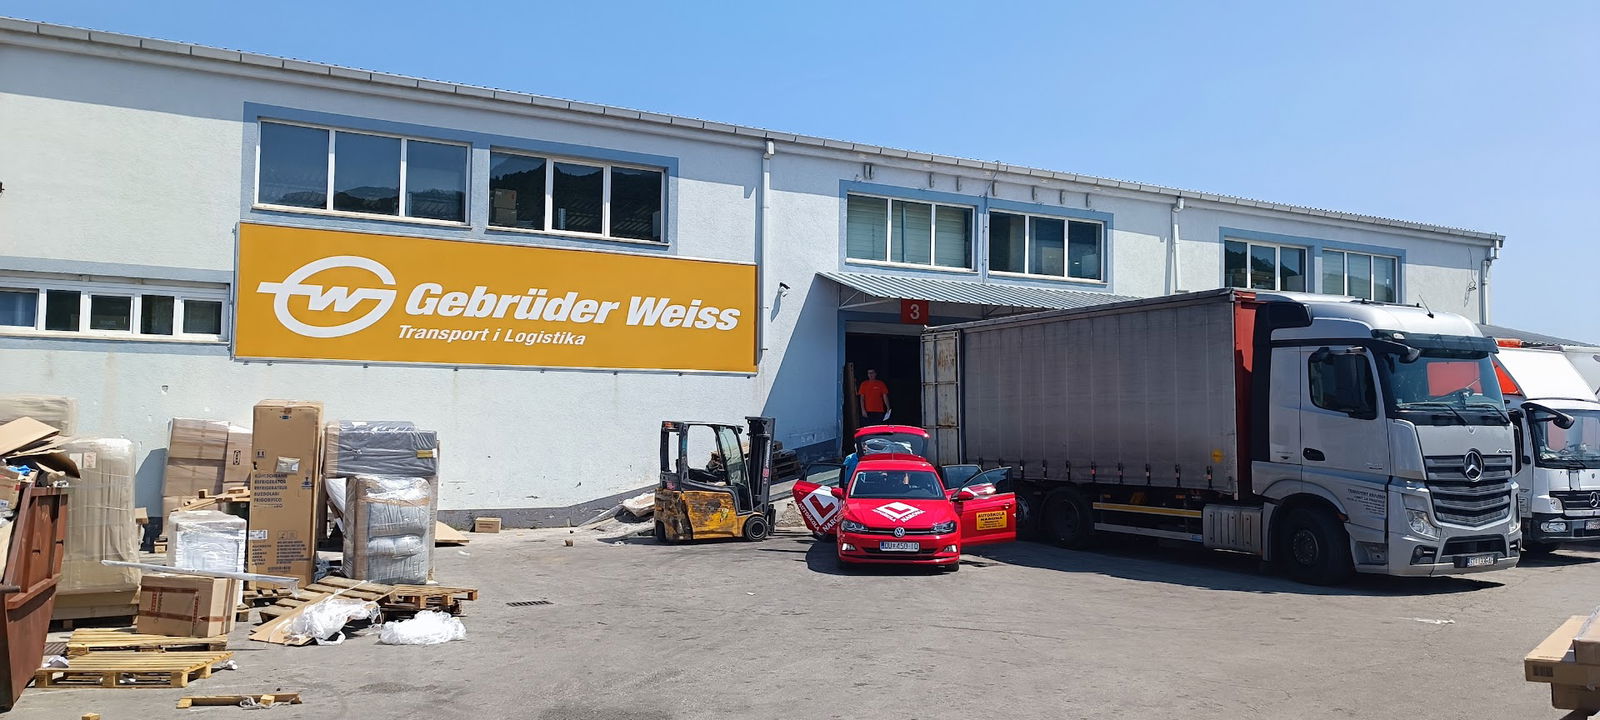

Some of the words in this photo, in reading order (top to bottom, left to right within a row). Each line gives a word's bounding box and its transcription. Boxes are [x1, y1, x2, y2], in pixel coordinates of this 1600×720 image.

[406, 283, 620, 323] Gebrüder
[627, 297, 740, 331] Weiss
[910, 303, 920, 320] 3
[398, 325, 489, 344] Transport
[492, 331, 500, 342] i
[504, 330, 586, 346] Logistika
